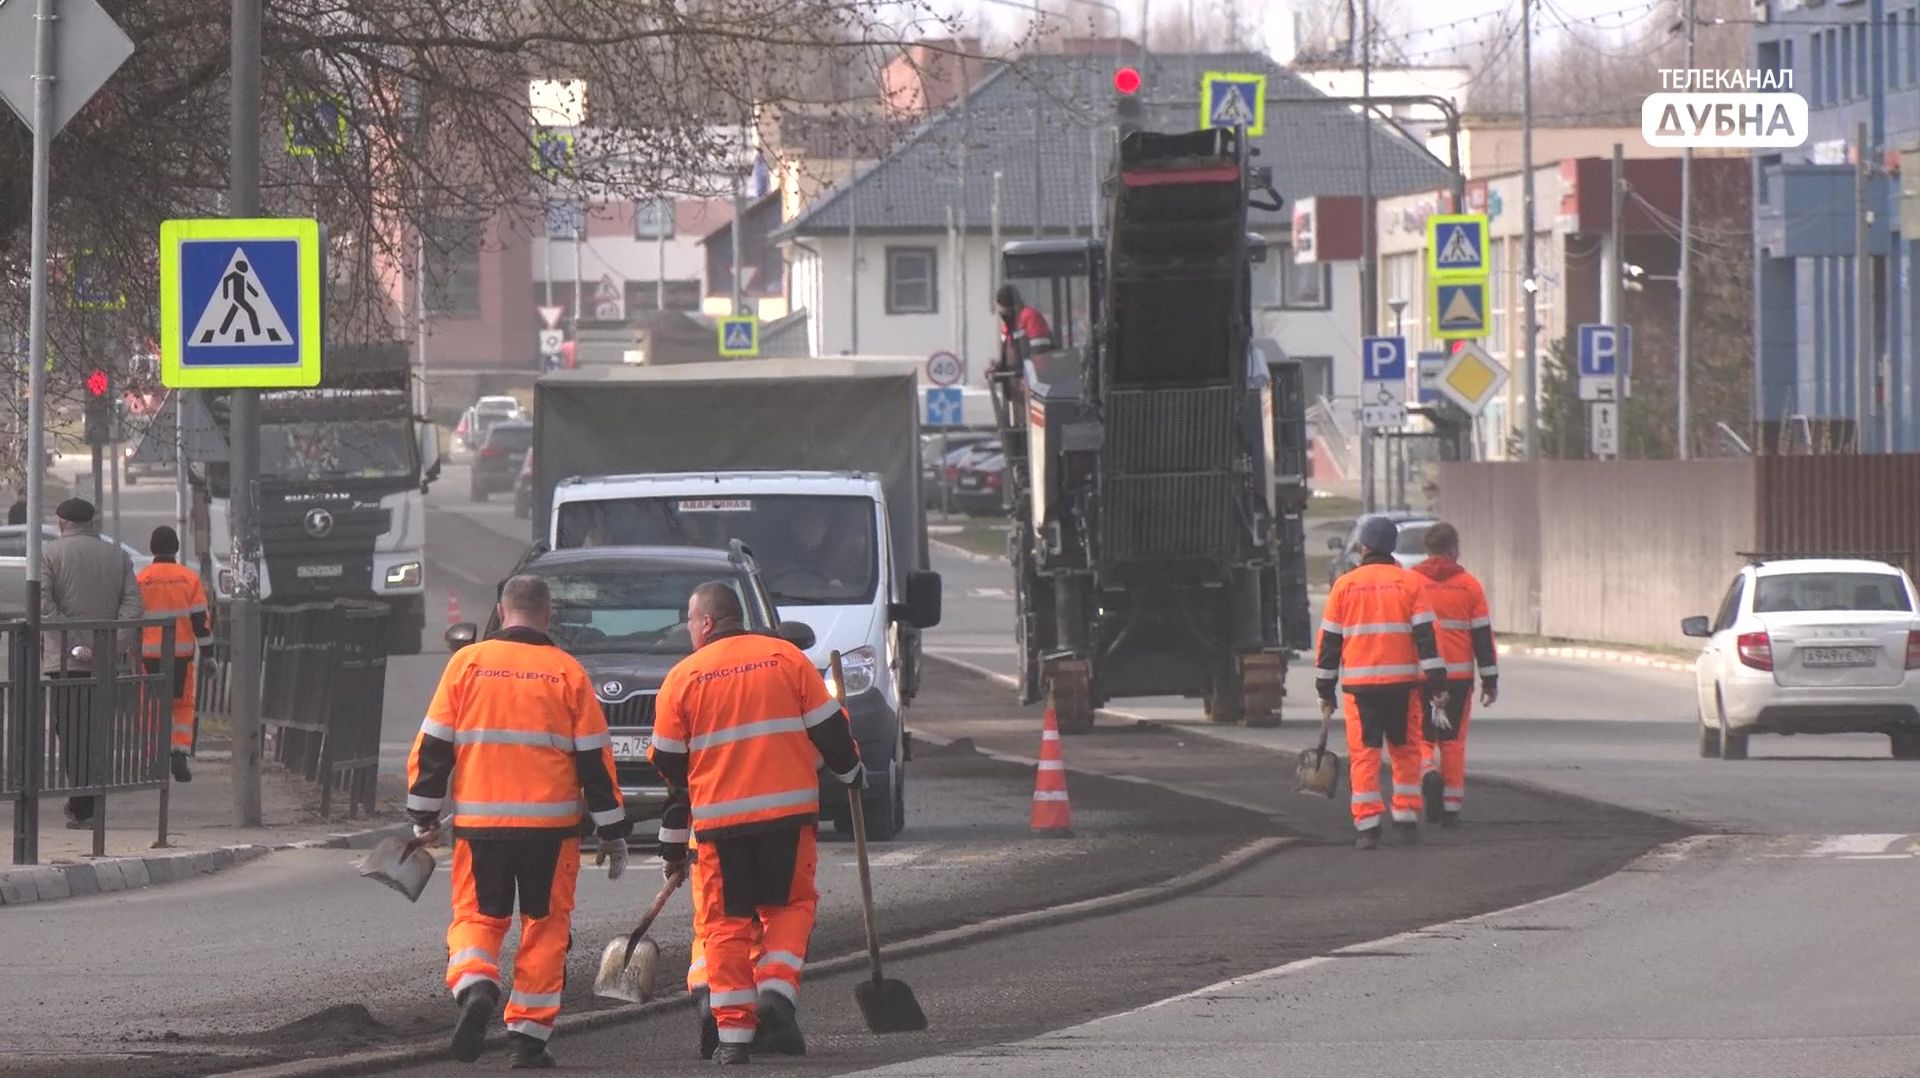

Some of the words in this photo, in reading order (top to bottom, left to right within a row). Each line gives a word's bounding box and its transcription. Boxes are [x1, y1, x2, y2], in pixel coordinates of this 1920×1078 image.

[933, 361, 955, 376] 40
[1371, 340, 1397, 377] P
[1591, 329, 1617, 371] P
